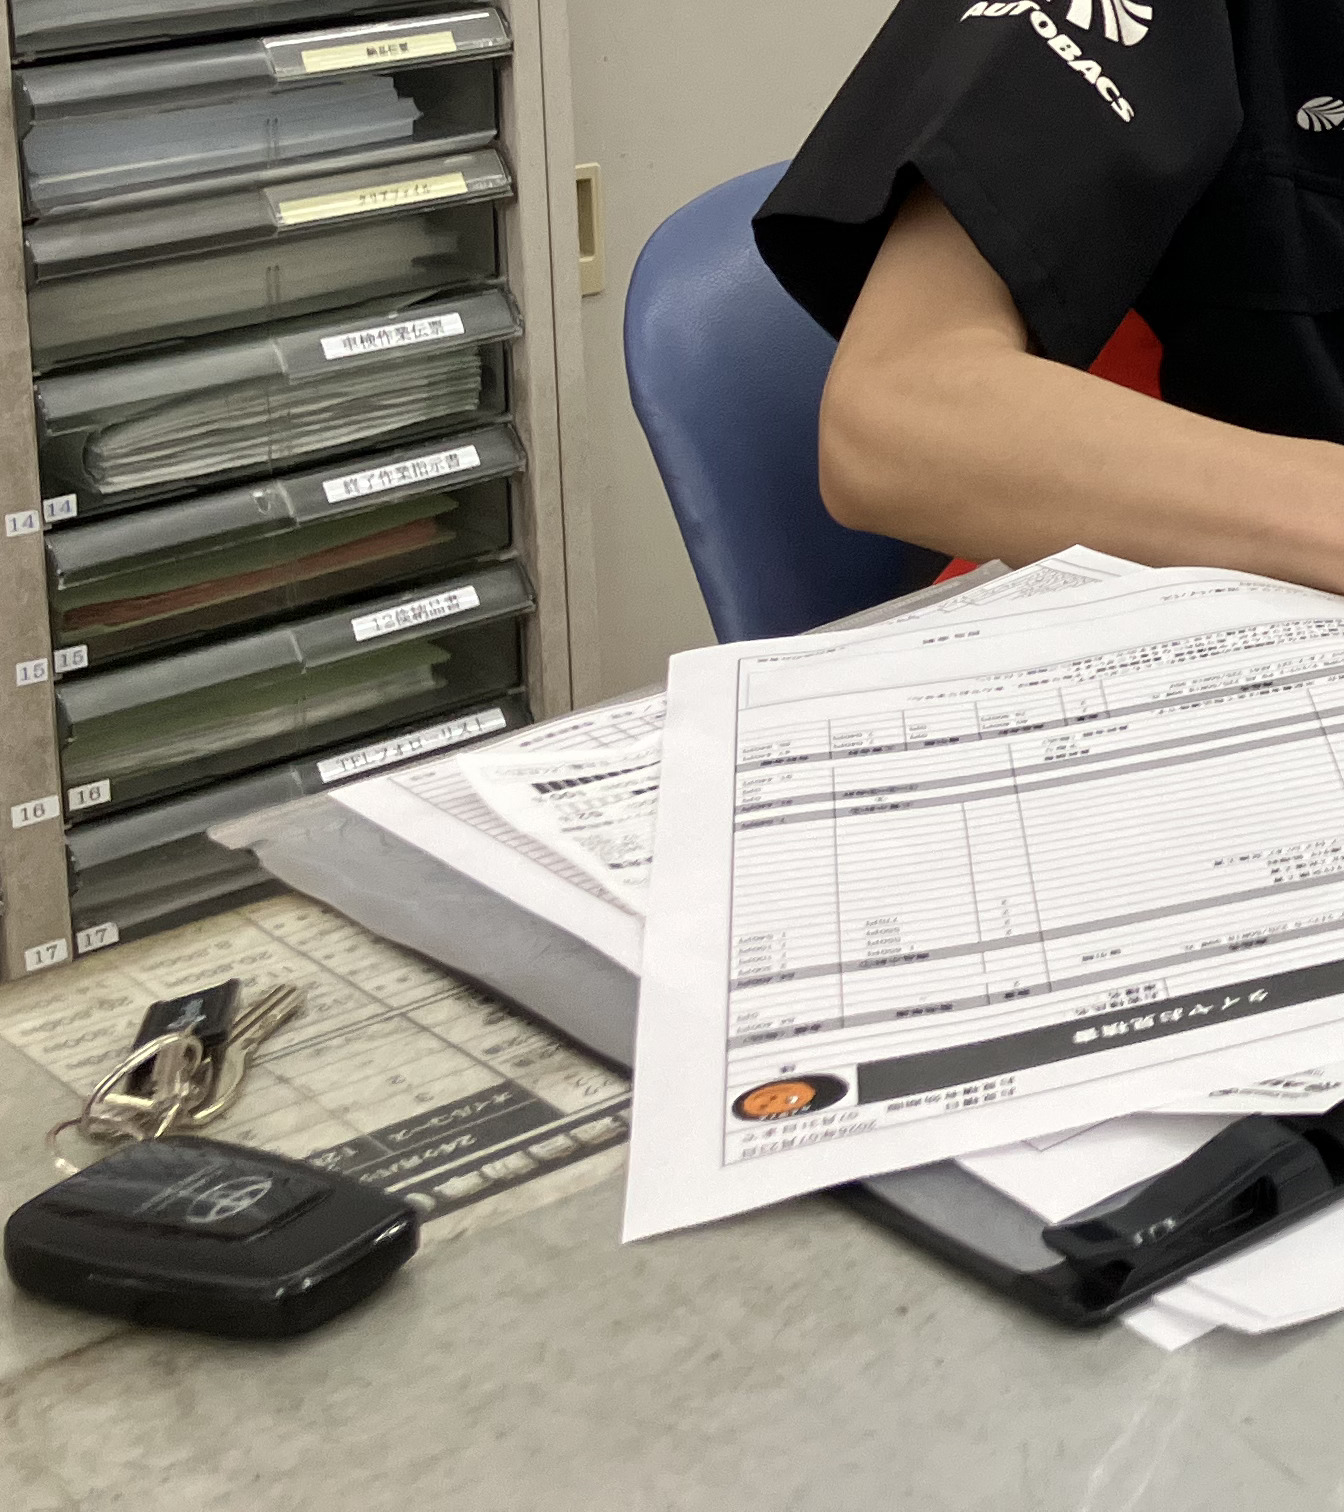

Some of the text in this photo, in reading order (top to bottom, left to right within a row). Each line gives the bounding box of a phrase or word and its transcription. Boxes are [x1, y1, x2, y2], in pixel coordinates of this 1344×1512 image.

[9, 499, 73, 533] 14 14
[19, 649, 85, 681] 15 15
[33, 928, 108, 964] 17 17
